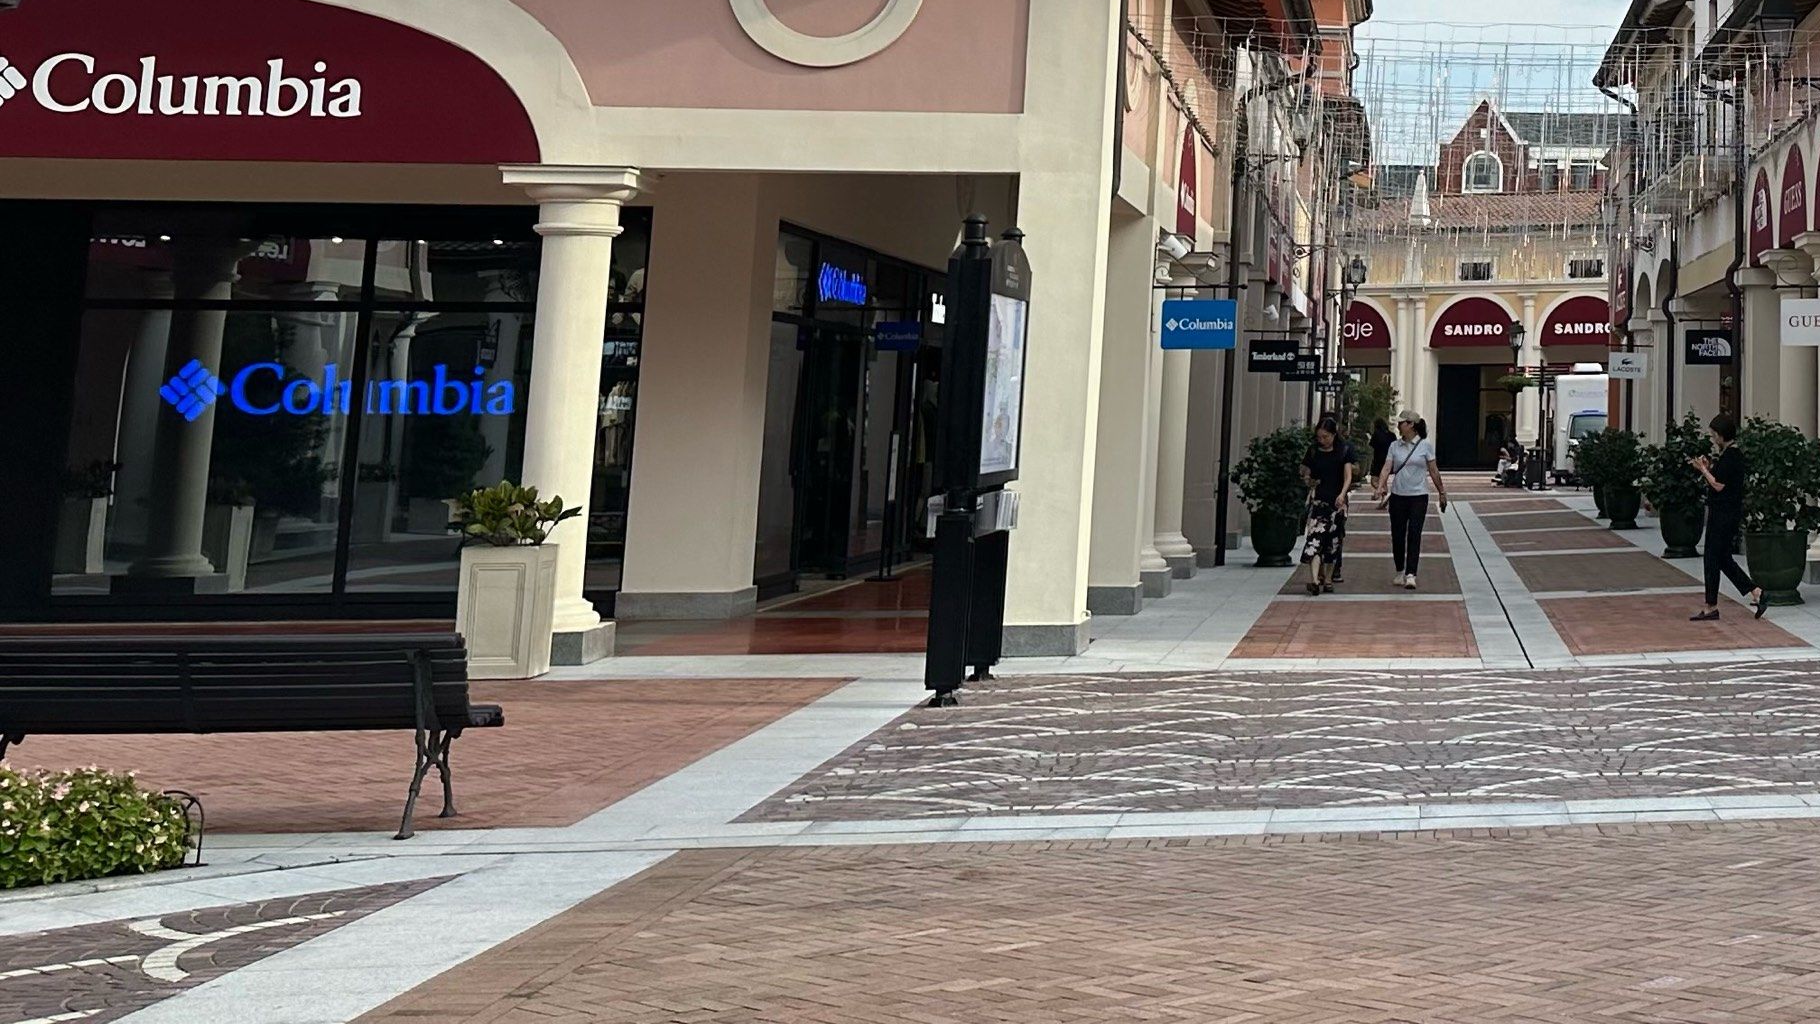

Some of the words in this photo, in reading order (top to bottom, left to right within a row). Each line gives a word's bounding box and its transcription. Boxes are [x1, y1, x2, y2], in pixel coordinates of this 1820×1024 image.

[32, 52, 362, 118] Columbia
[1179, 318, 1234, 331] Columbia
[1343, 319, 1374, 341] aje
[1444, 324, 1503, 336] SANDRO
[1691, 343, 1718, 351] NORTH
